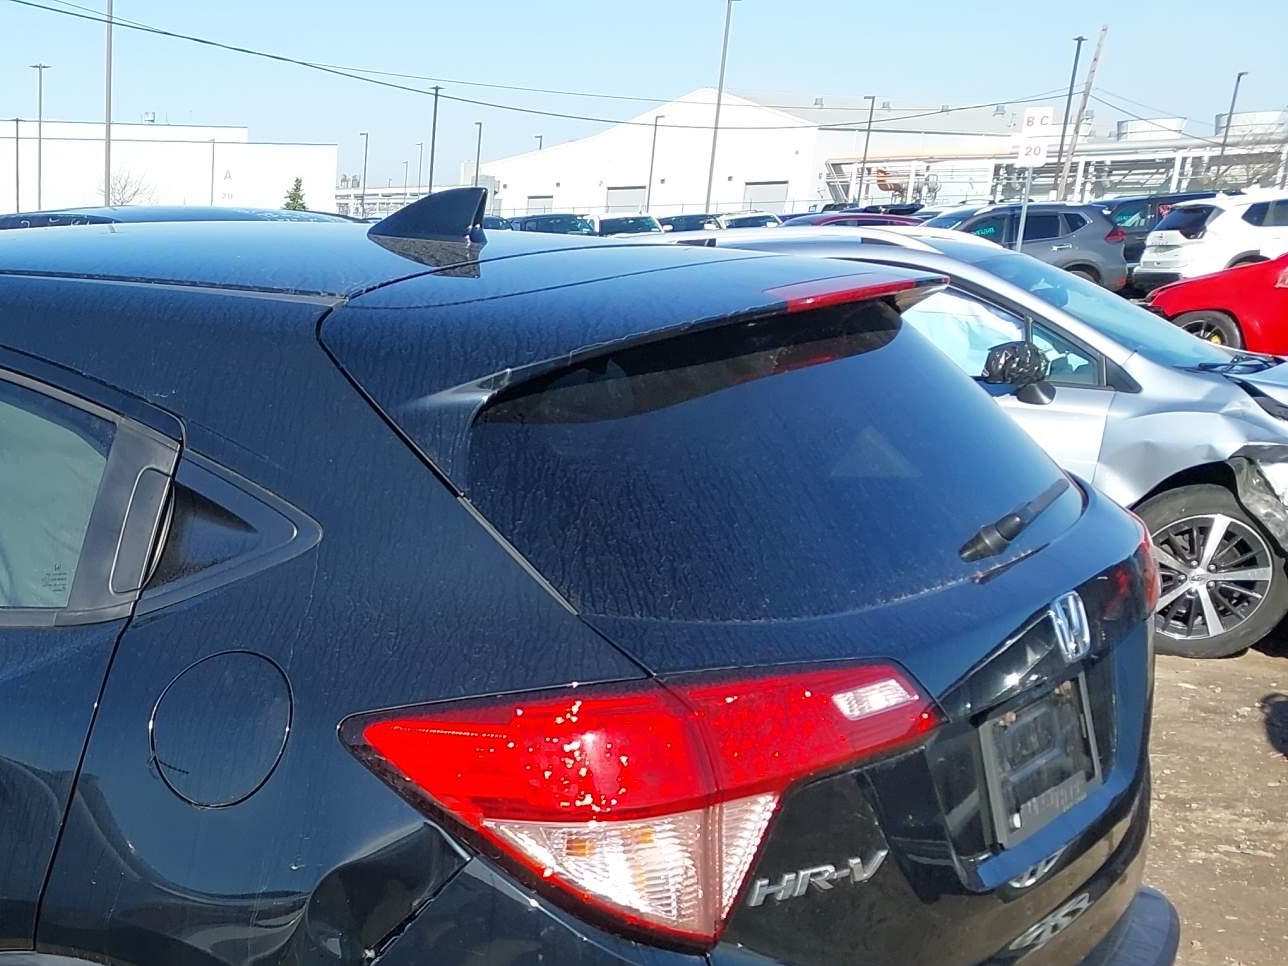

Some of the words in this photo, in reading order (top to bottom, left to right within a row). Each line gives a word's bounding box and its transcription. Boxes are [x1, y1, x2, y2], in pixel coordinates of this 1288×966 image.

[1026, 115, 1035, 127] B
[1040, 115, 1050, 126] C
[1024, 145, 1041, 157] 20
[747, 849, 889, 907] HR-V
